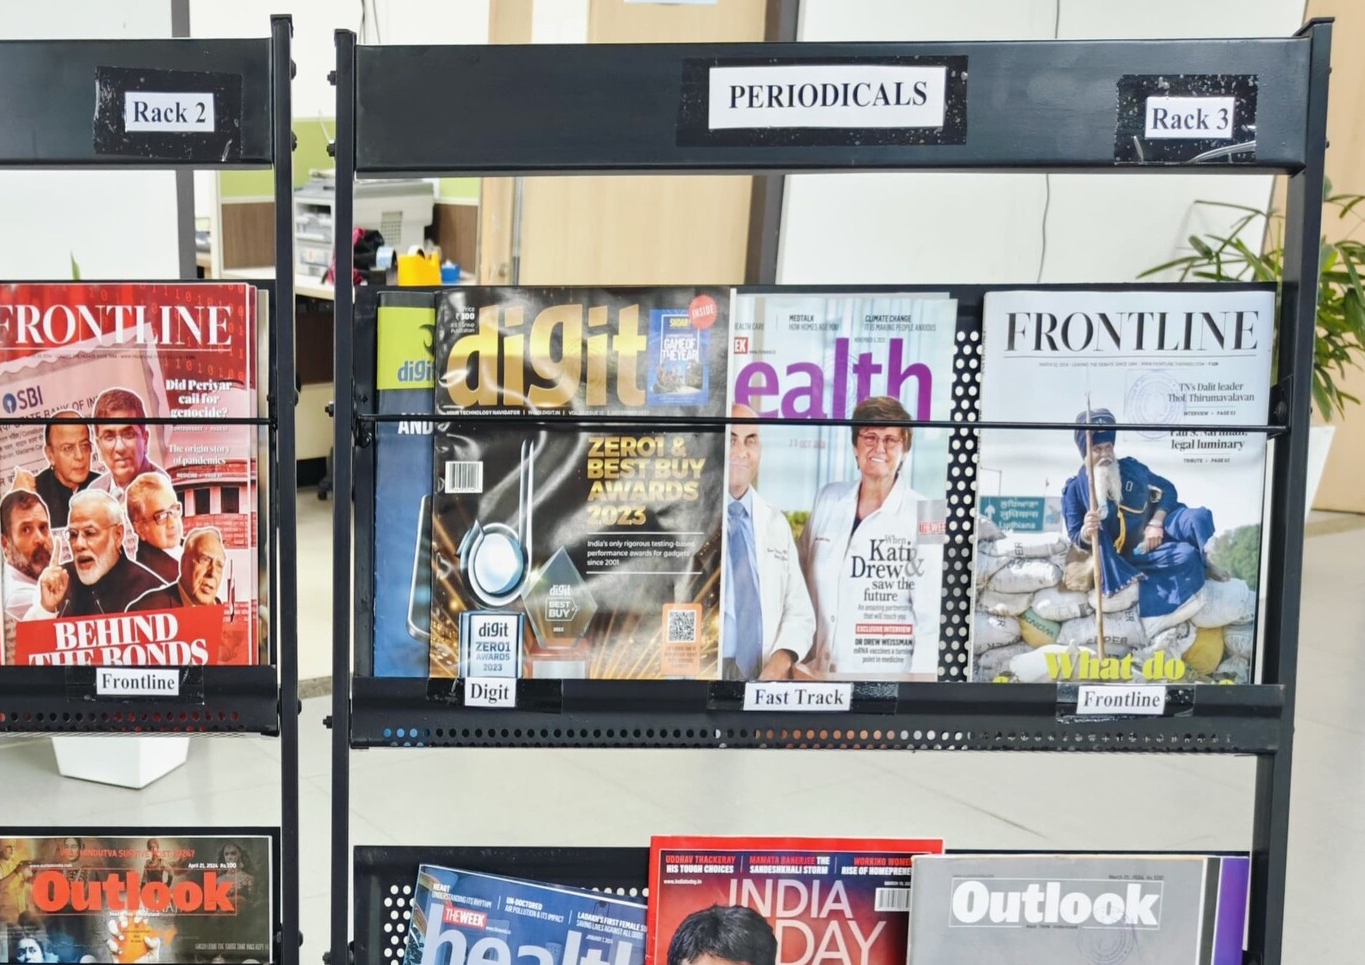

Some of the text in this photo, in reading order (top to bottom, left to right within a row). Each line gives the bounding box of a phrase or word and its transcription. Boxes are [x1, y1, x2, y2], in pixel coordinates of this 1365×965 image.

[728, 81, 928, 112] PERIODICALS
[133, 100, 206, 124] Rack 2
[1151, 107, 1229, 135] Rack 3
[1005, 310, 1259, 354] FRONTLINE
[447, 303, 649, 408] digit
[166, 380, 232, 394] Did Periyar
[587, 458, 706, 480] BEST BUY
[850, 556, 903, 579] Drew
[863, 589, 898, 602] future
[54, 613, 179, 650] BEHIND
[478, 622, 509, 639] digit
[101, 673, 175, 691] Frontline
[469, 681, 510, 703] Digit
[754, 688, 844, 707] Fast Track
[1083, 690, 1161, 709] Frontline
[32, 870, 237, 912] Outlook
[952, 880, 1161, 926] Outlook
